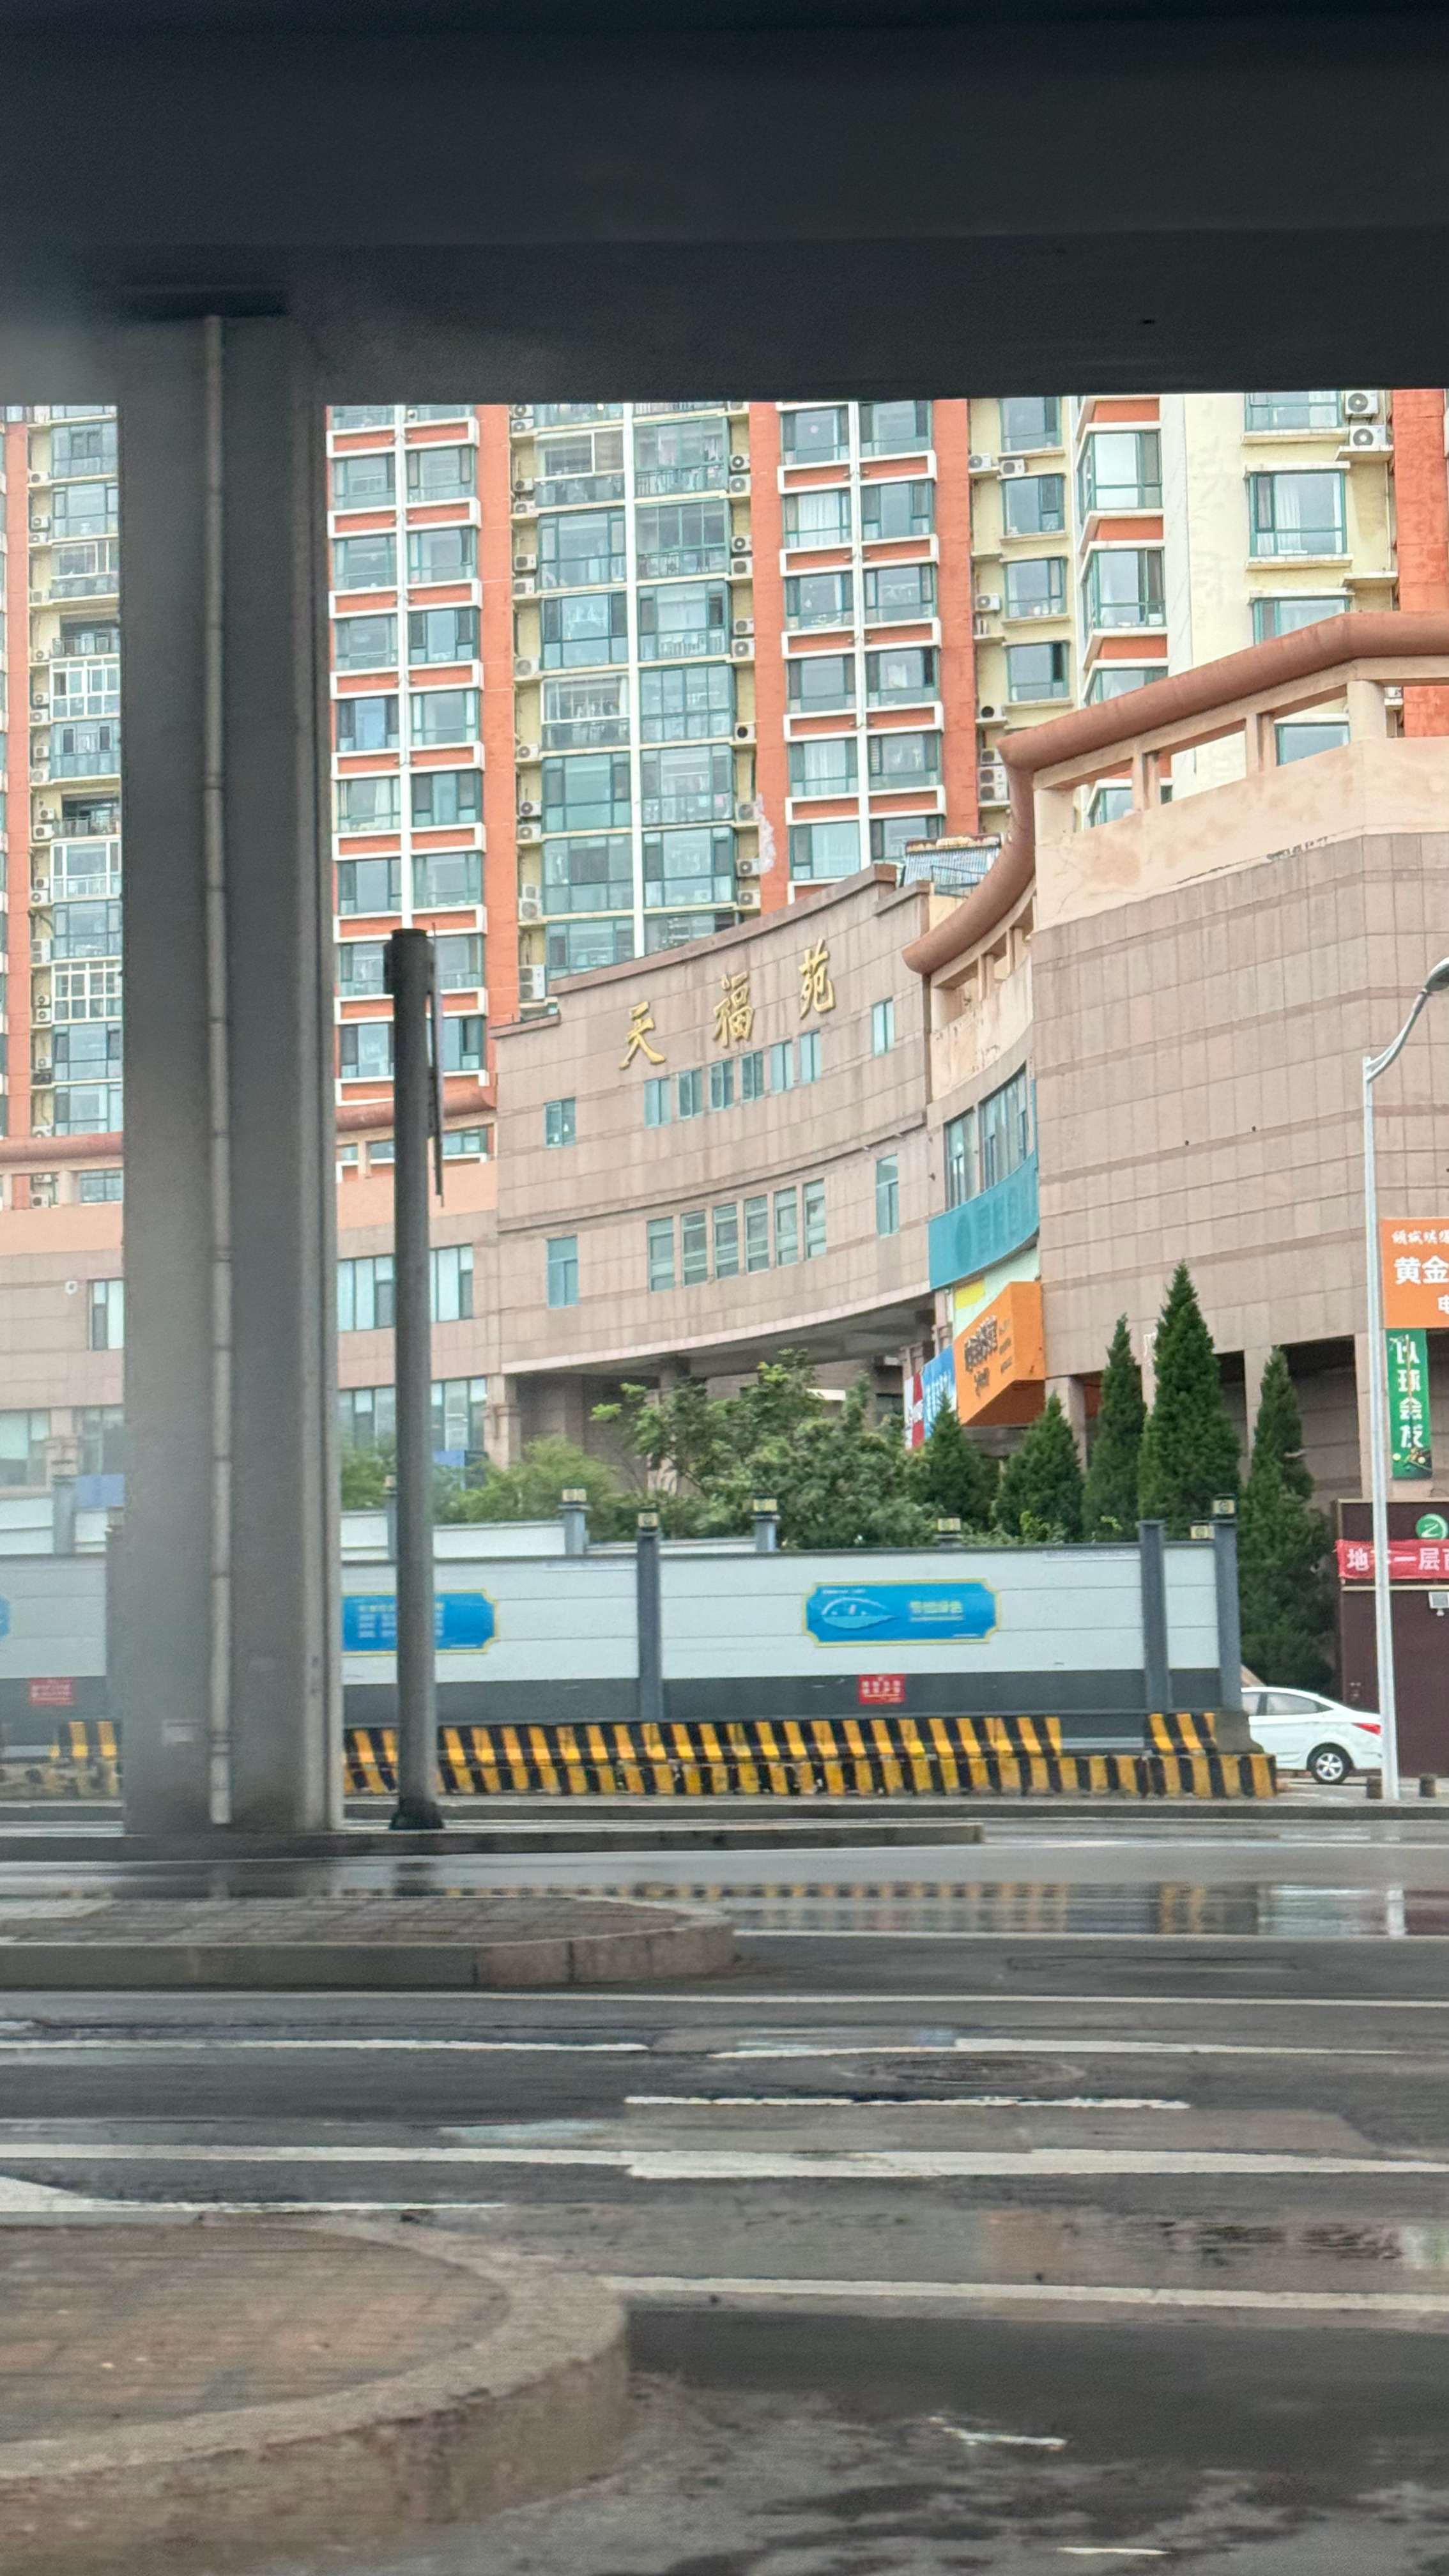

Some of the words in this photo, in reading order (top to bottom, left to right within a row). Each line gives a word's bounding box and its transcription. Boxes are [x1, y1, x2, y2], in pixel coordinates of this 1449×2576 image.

[618, 937, 836, 1071] 天福苑
[1393, 1254, 1449, 1285] 黄金
